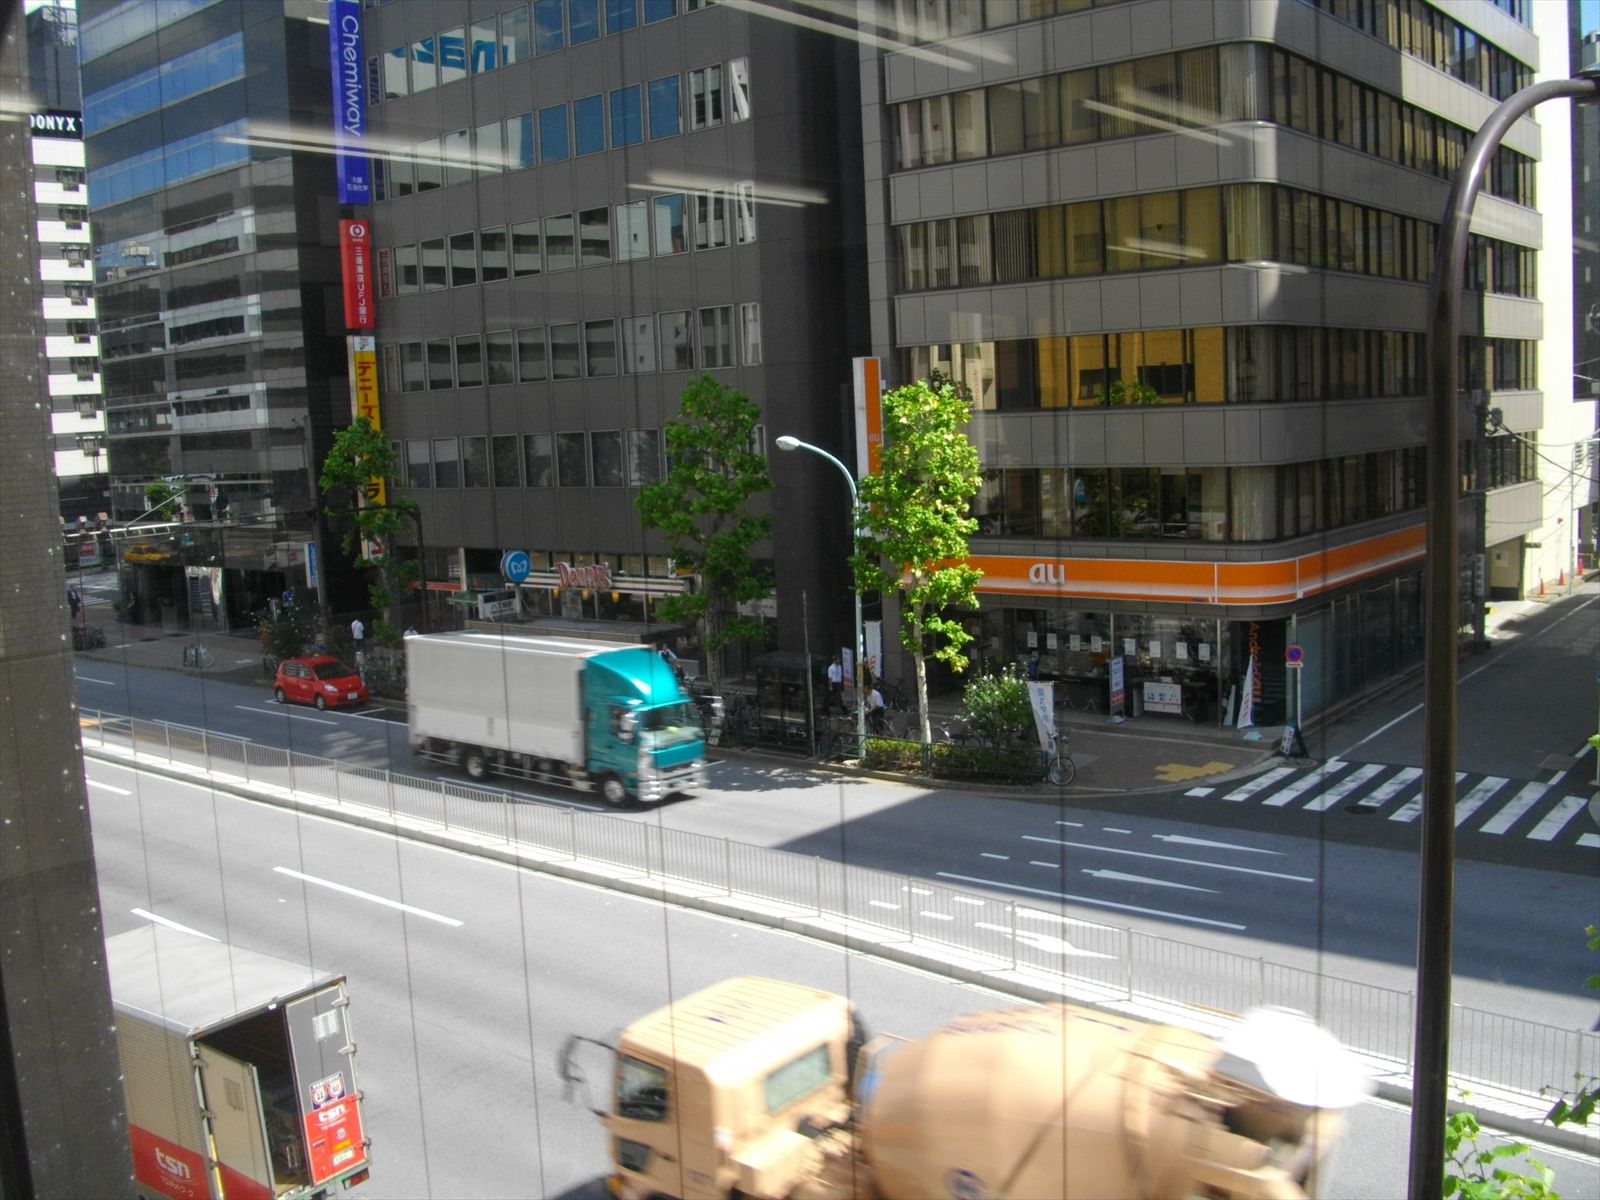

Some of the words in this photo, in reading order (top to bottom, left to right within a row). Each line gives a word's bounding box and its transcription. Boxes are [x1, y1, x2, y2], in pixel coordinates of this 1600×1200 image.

[342, 15, 362, 137] Chemiway
[358, 360, 377, 420] デニーズ
[868, 433, 881, 442] au
[1028, 563, 1065, 585] au
[318, 1103, 345, 1122] tsn
[155, 1146, 191, 1179] tsn
